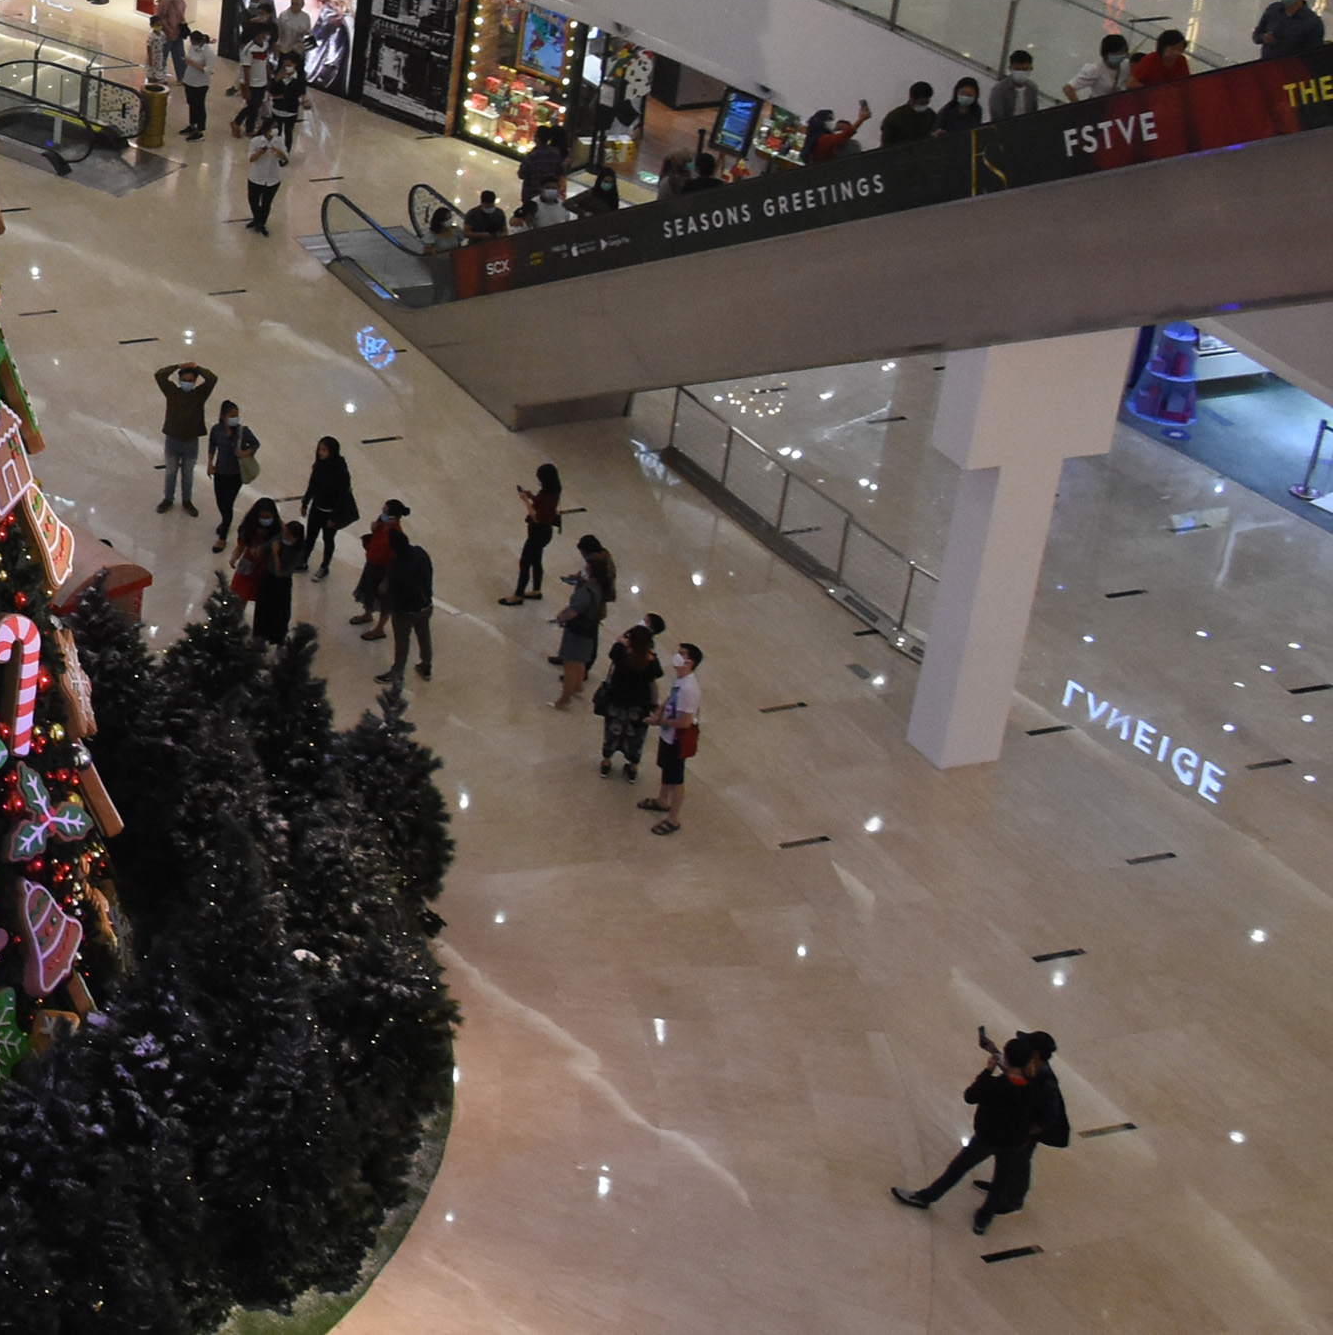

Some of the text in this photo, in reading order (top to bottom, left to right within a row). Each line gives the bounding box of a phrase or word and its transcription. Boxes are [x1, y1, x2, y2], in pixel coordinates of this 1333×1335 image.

[1284, 75, 1333, 108] THE
[1063, 111, 1159, 157] FSTVE
[663, 174, 884, 238] SEASONS GREETINGS
[486, 259, 511, 275] SCX
